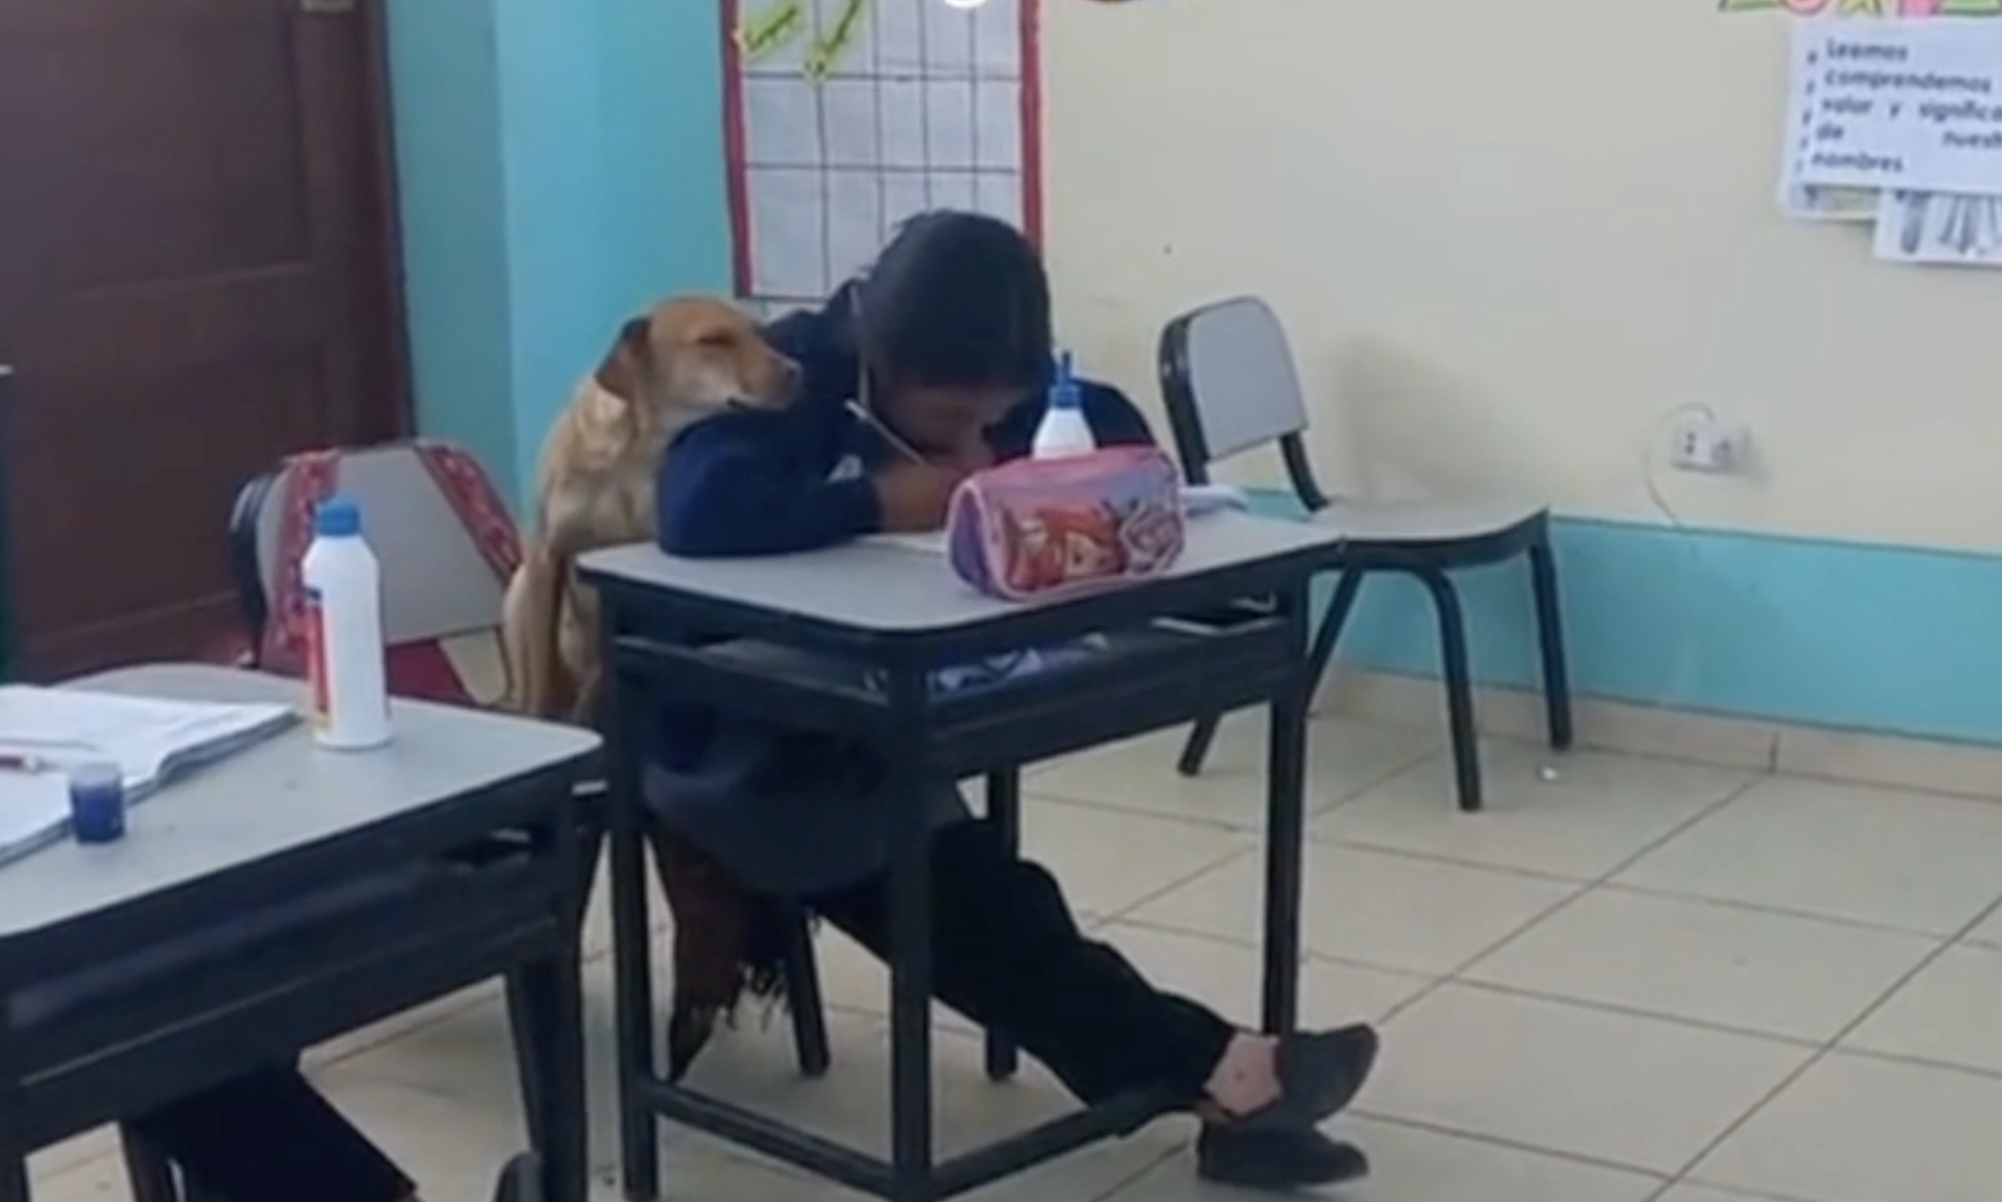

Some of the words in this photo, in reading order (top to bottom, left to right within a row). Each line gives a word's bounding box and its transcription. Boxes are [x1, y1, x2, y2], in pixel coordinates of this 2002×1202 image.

[1826, 38, 1908, 61] Leemos
[1824, 69, 1992, 94] comprendemos
[1822, 96, 1872, 114] valor
[1889, 102, 1901, 119] y
[1816, 121, 1843, 140] de
[1811, 152, 1903, 172] nombres
